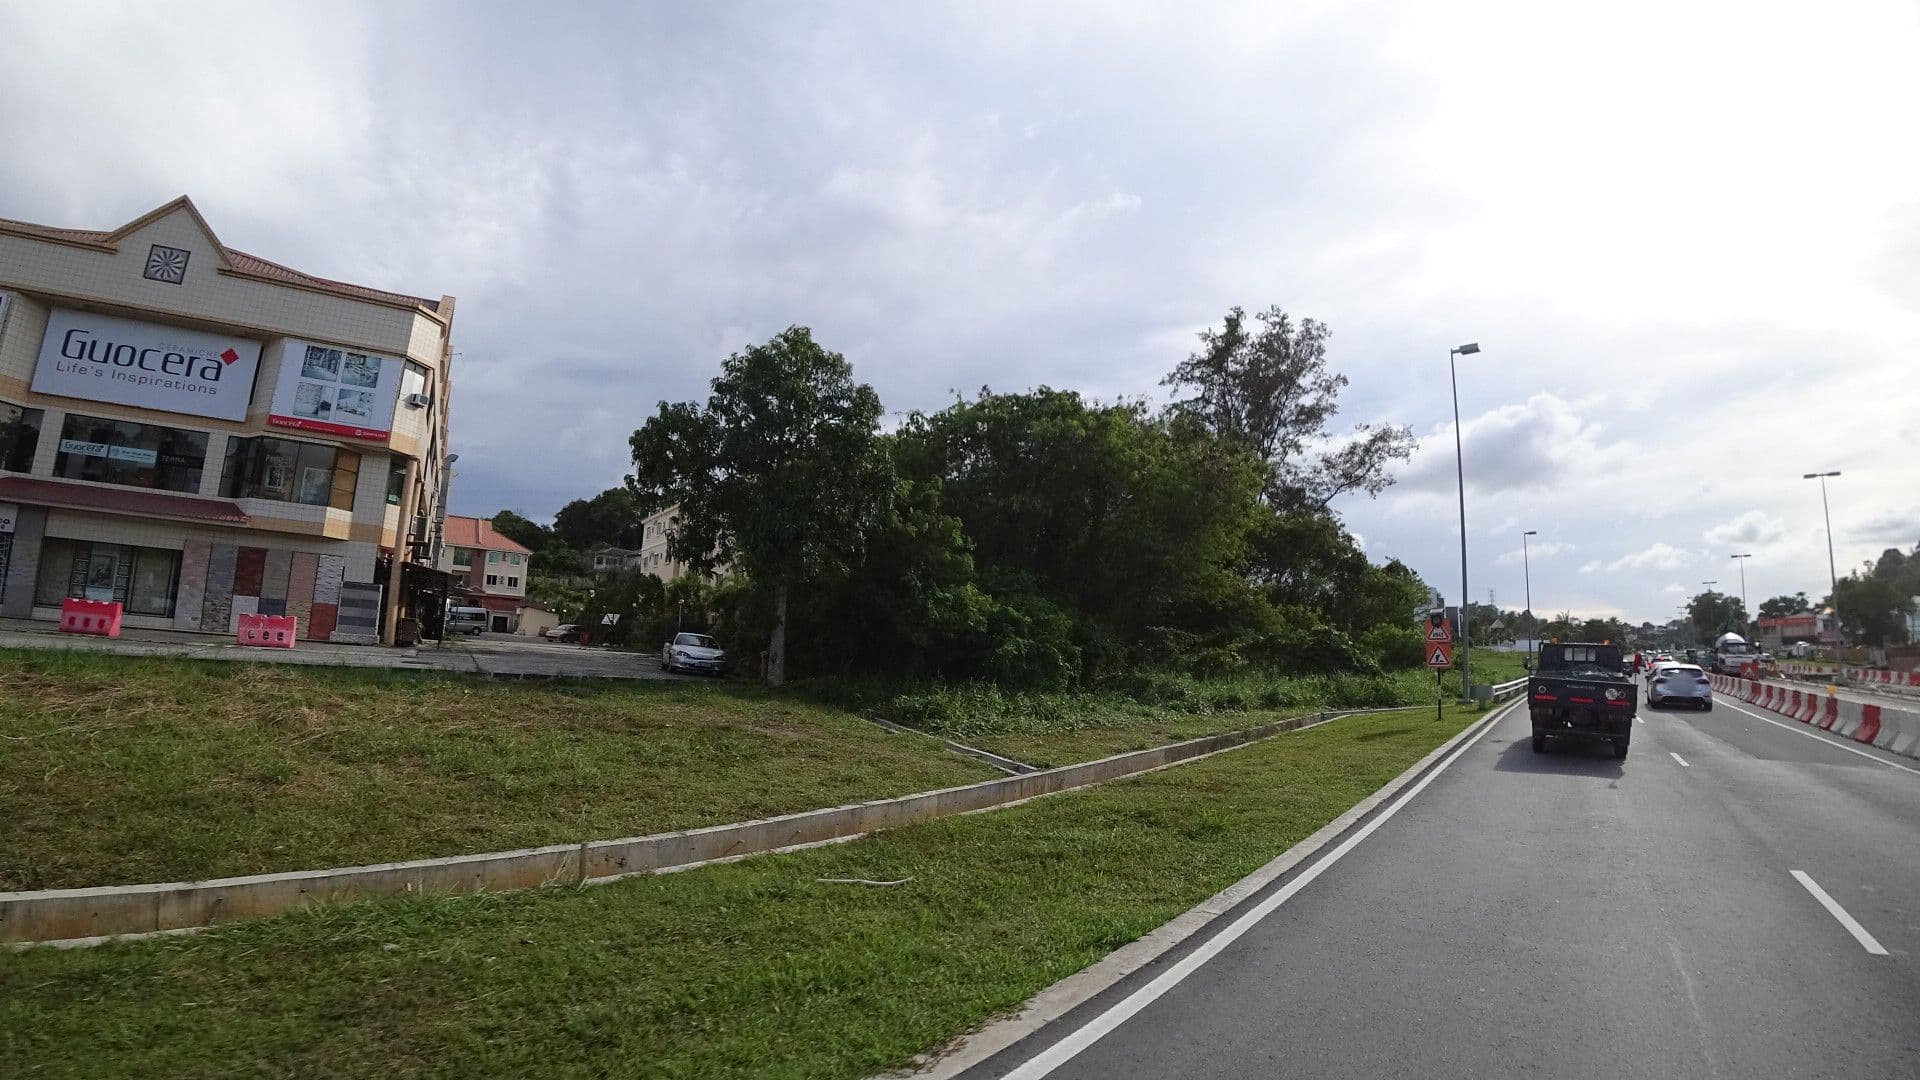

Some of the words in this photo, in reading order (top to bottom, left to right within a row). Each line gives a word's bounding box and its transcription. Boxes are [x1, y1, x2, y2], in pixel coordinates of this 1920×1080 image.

[61, 329, 223, 382] Guocera
[56, 361, 104, 377] Life's
[111, 368, 217, 395] Inspirations
